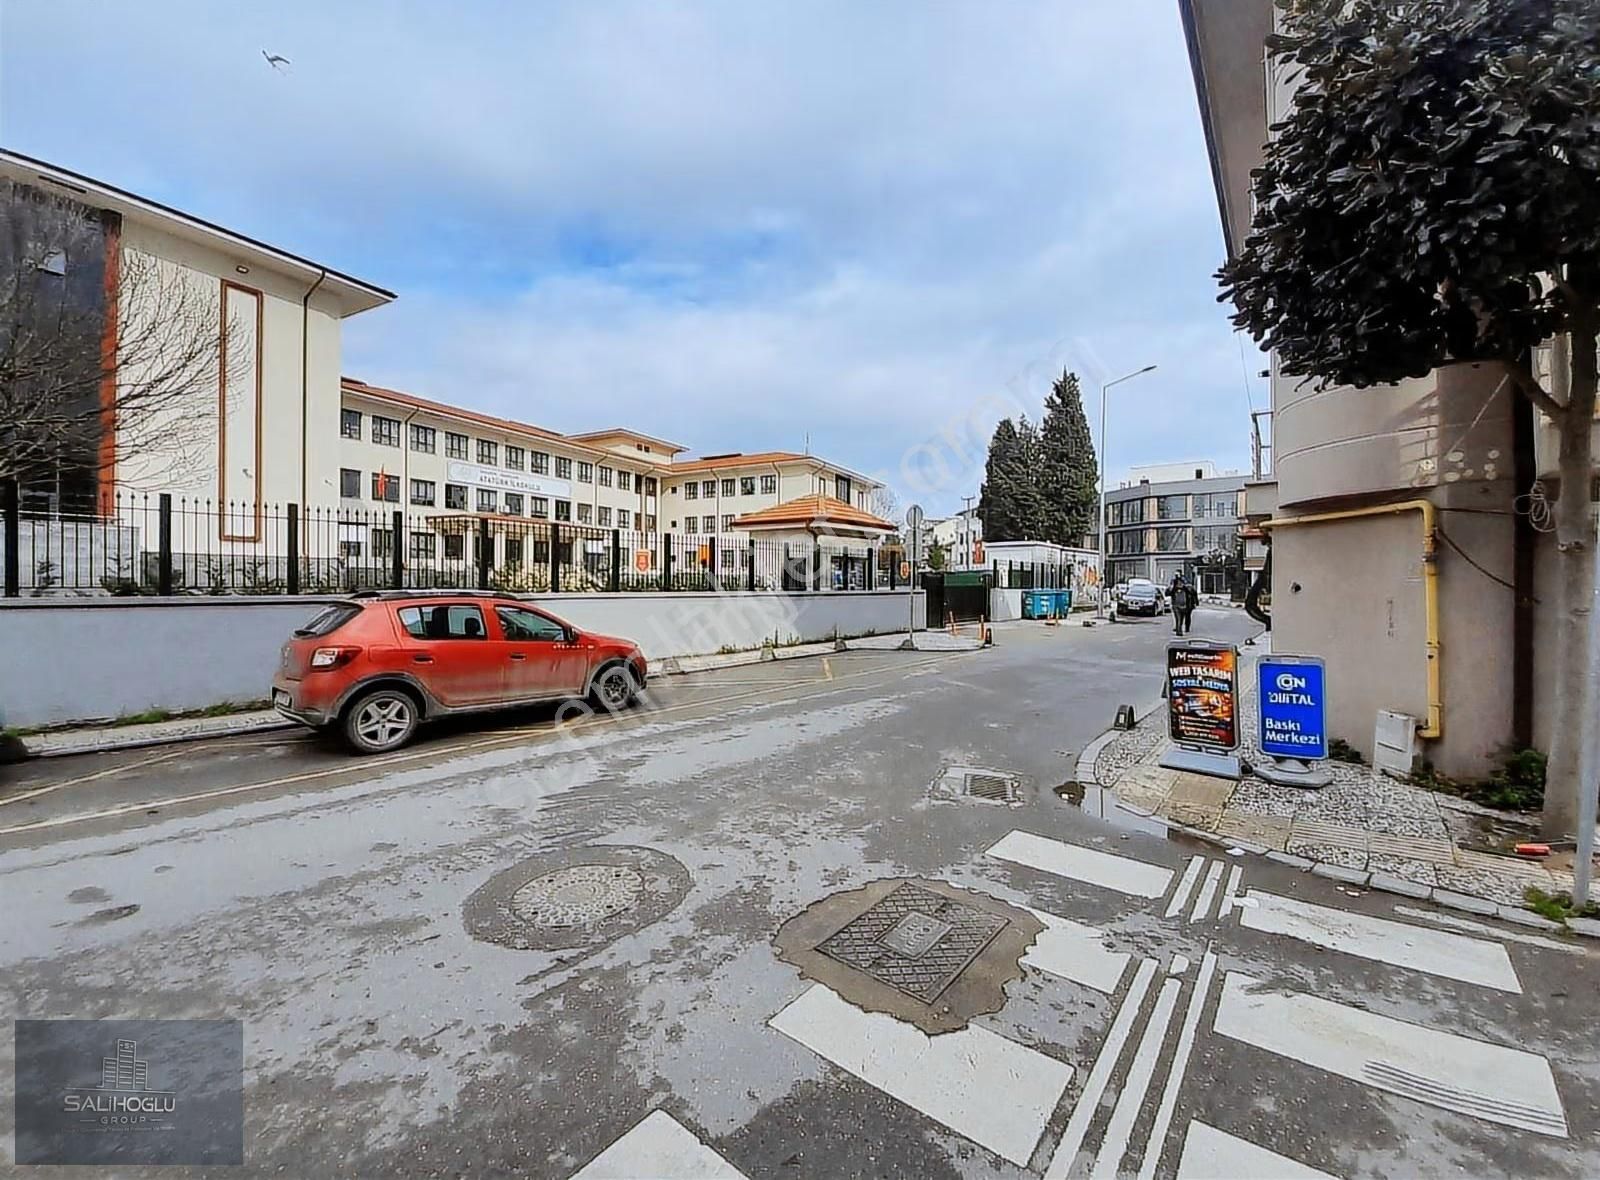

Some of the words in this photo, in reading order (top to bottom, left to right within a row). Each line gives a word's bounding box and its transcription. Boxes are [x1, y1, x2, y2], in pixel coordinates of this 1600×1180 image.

[1169, 666, 1191, 677] WEB
[1192, 666, 1232, 681] TASARIM
[1265, 717, 1301, 731] Baskı
[1265, 730, 1320, 745] Merkezi
